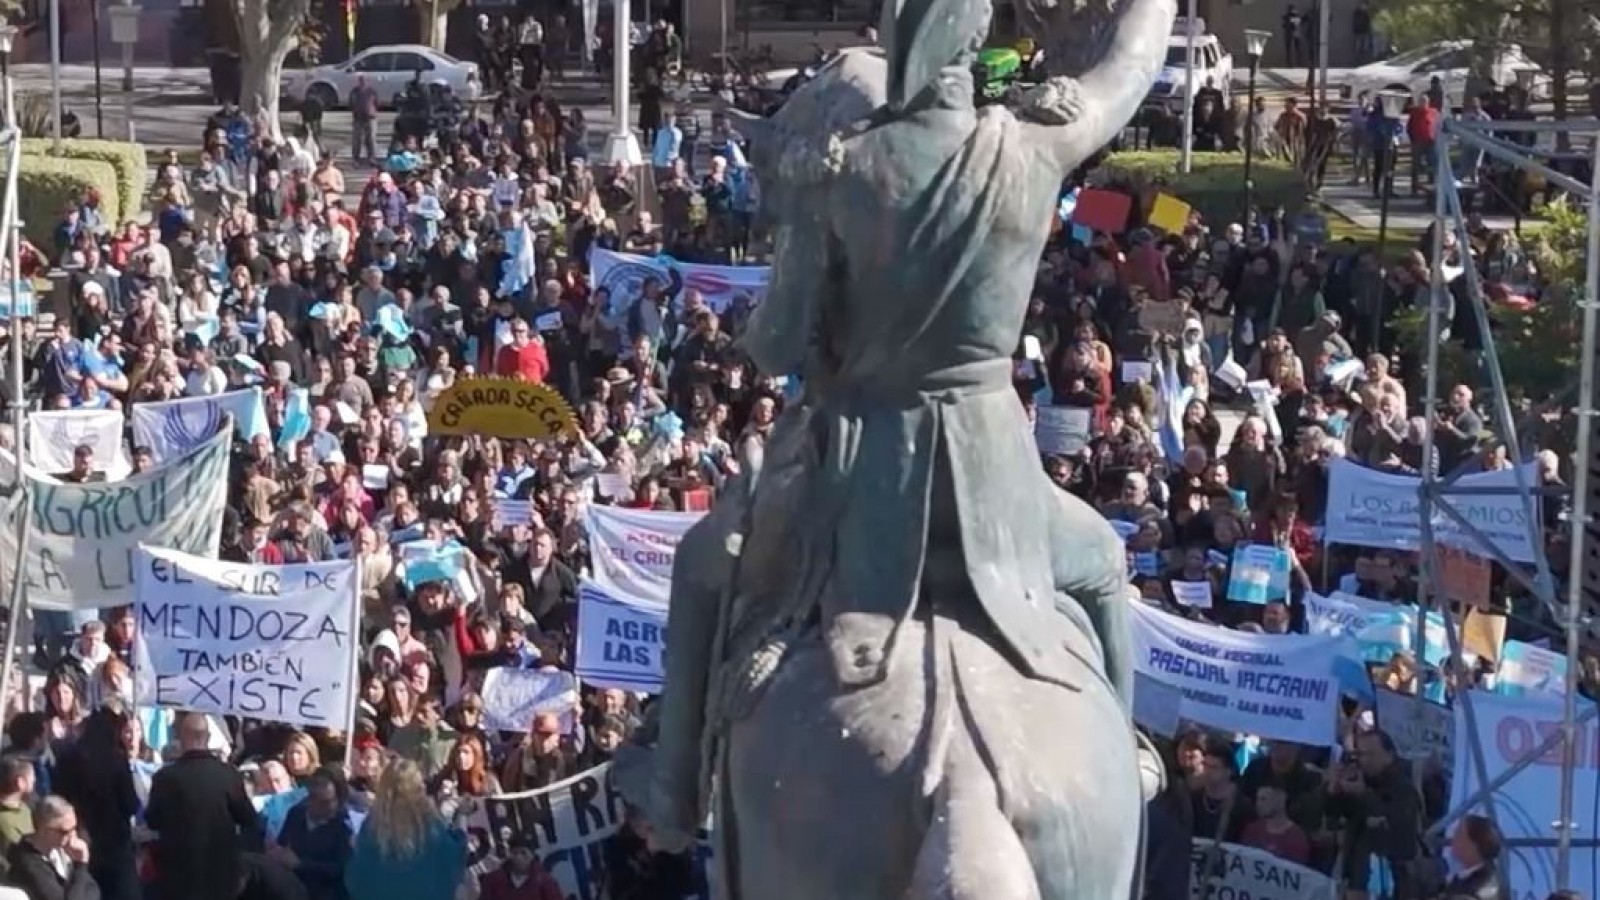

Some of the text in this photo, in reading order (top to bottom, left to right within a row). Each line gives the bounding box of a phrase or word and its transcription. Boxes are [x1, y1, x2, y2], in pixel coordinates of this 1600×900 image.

[151, 558, 337, 596] EL SUR DE
[141, 602, 348, 648] MENDOZA
[603, 641, 650, 666] LAS
[1149, 648, 1329, 701] PASCUAL IACCARINI
[1253, 860, 1301, 892] SAN
